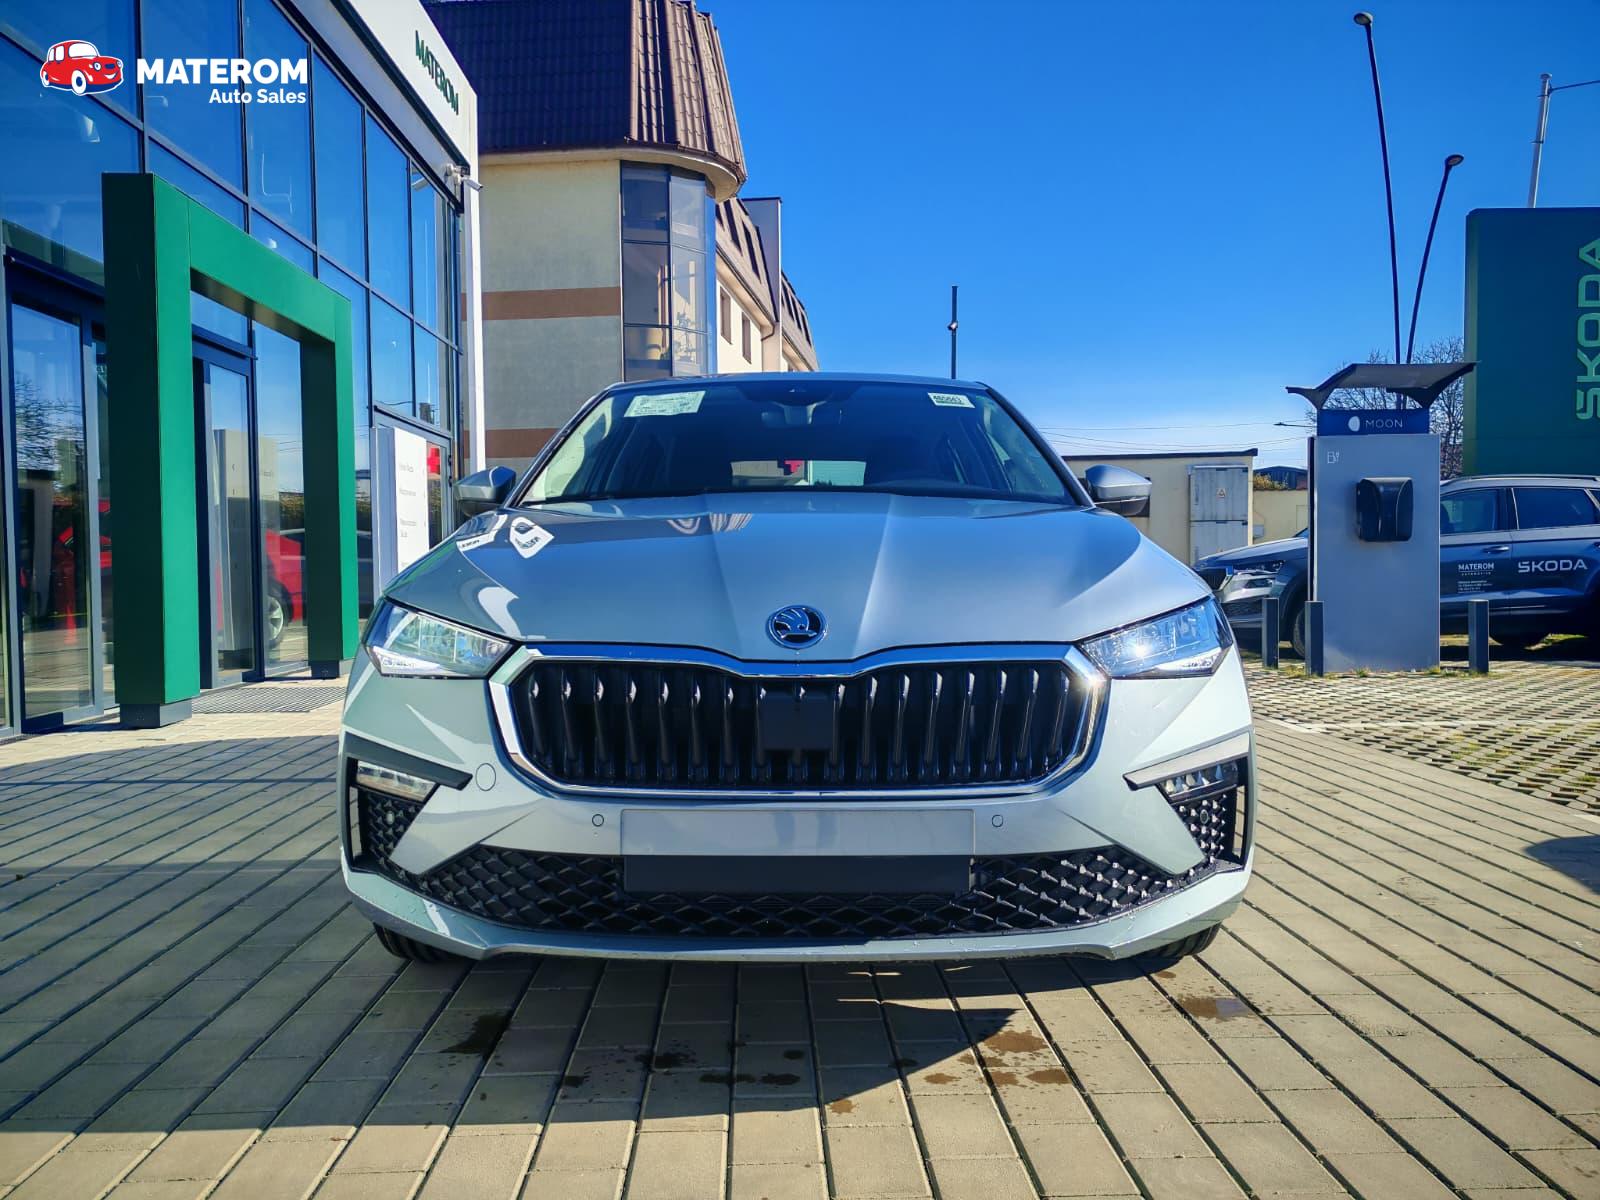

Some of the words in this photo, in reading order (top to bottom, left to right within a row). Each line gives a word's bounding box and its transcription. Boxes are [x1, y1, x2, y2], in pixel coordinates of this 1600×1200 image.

[415, 30, 459, 116] MATEROM
[1365, 419, 1403, 428] MOON
[1458, 562, 1494, 571] MATEROM
